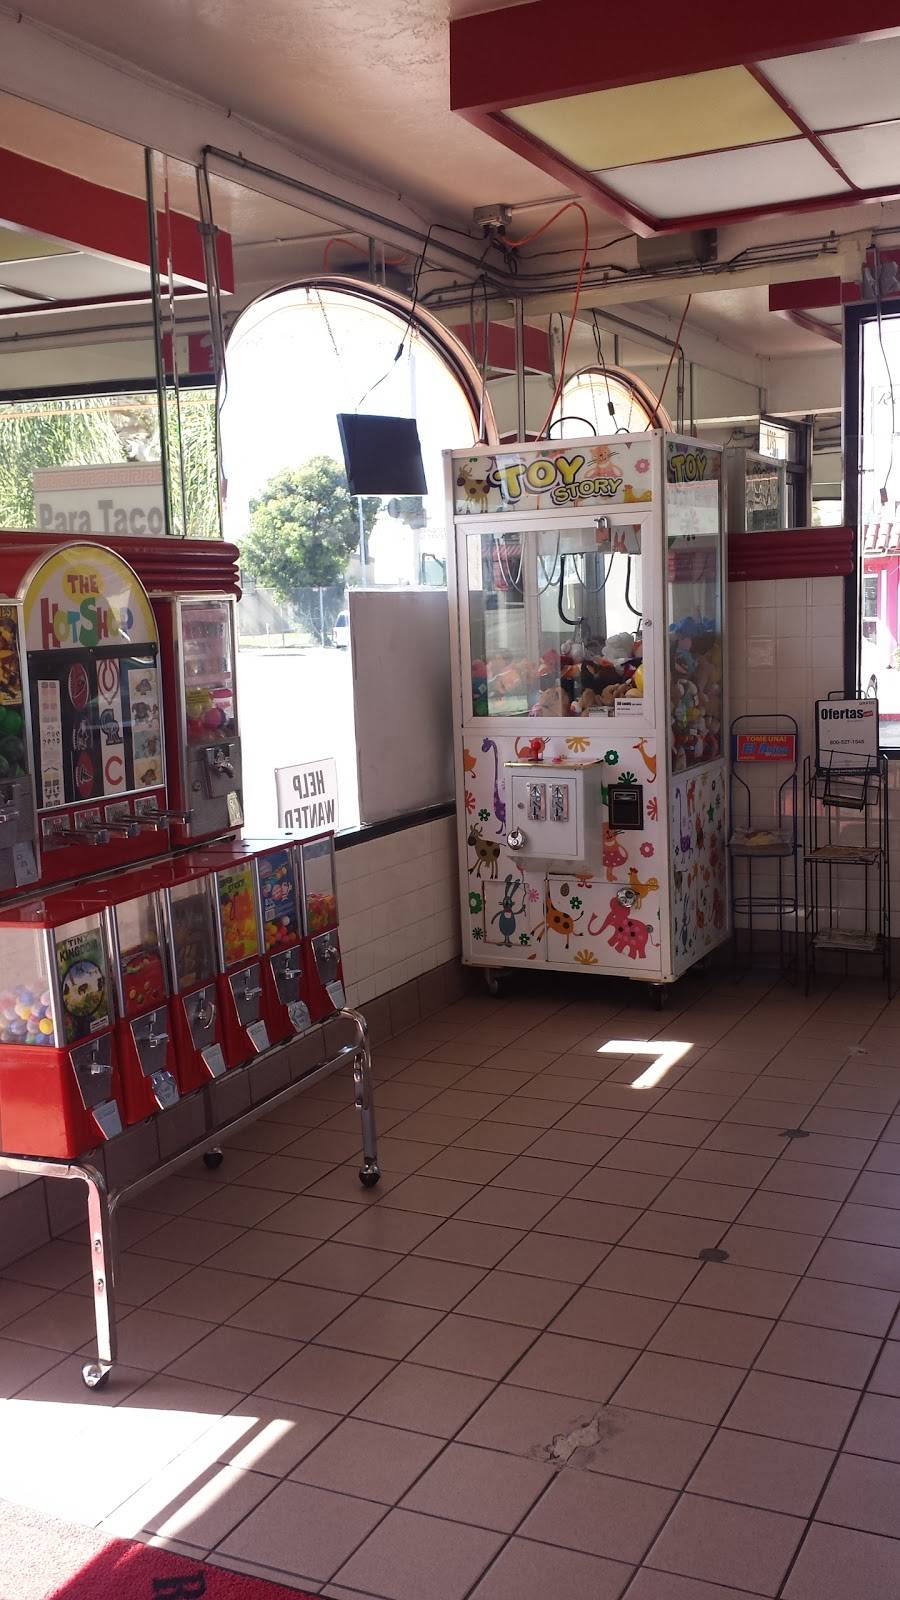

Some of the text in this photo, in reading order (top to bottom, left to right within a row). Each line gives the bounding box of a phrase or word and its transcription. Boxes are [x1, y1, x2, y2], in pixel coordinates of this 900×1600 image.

[493, 454, 586, 503] TOY
[671, 454, 707, 482] TOY
[551, 477, 624, 506] STORY
[40, 504, 91, 532] Para
[66, 574, 100, 594] THE
[821, 708, 864, 720] Ofertas
